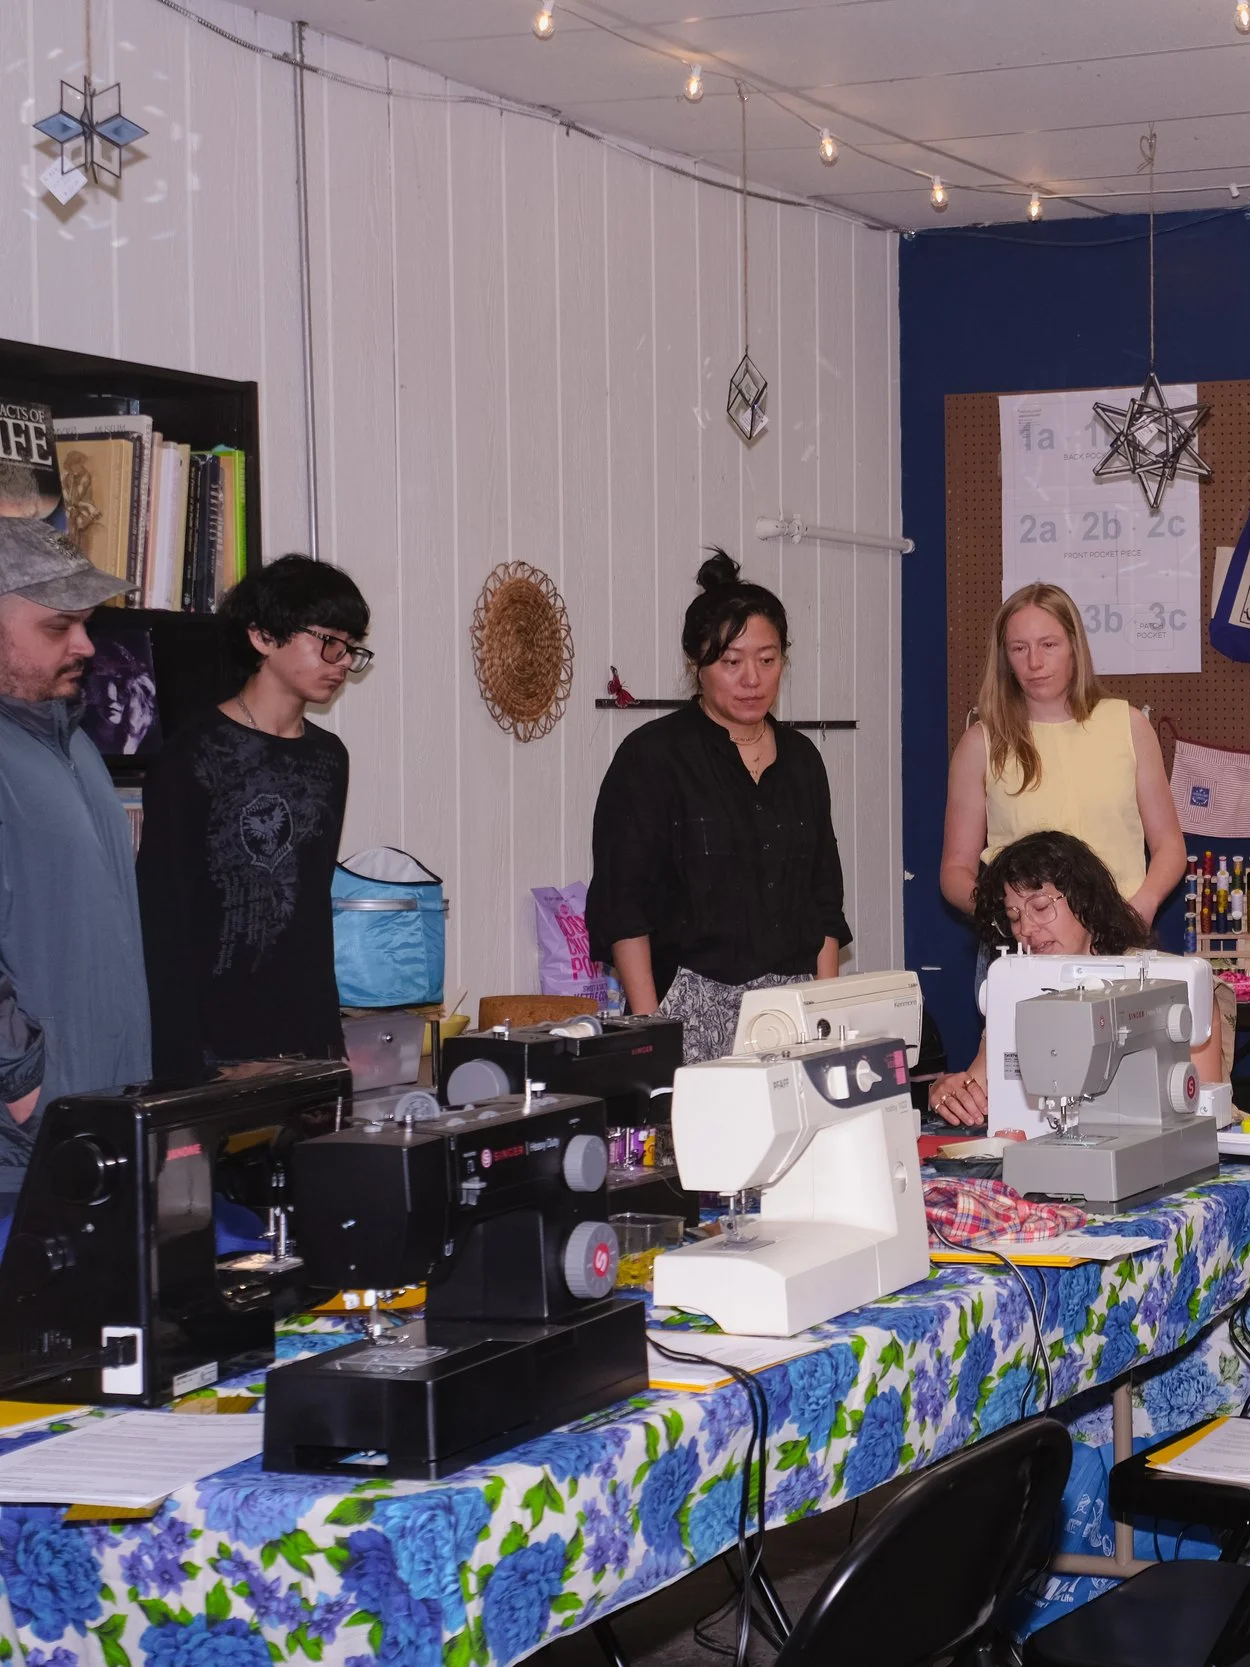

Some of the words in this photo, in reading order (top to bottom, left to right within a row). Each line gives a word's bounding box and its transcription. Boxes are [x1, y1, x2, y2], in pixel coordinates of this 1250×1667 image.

[30, 408, 45, 423] OF
[0, 418, 53, 466] FE
[1019, 422, 1055, 452] 1a
[1019, 514, 1057, 543] 2a
[1082, 511, 1122, 541] 2b
[1147, 512, 1186, 538] 2c
[1063, 552, 1088, 560] FRONT
[1089, 550, 1119, 558] POCKET
[1120, 549, 1142, 557] PIECE
[1084, 604, 1123, 634] 3b
[1150, 602, 1187, 631] 3c
[1139, 622, 1164, 630] PATCH
[1129, 1011, 1145, 1020] SINGER
